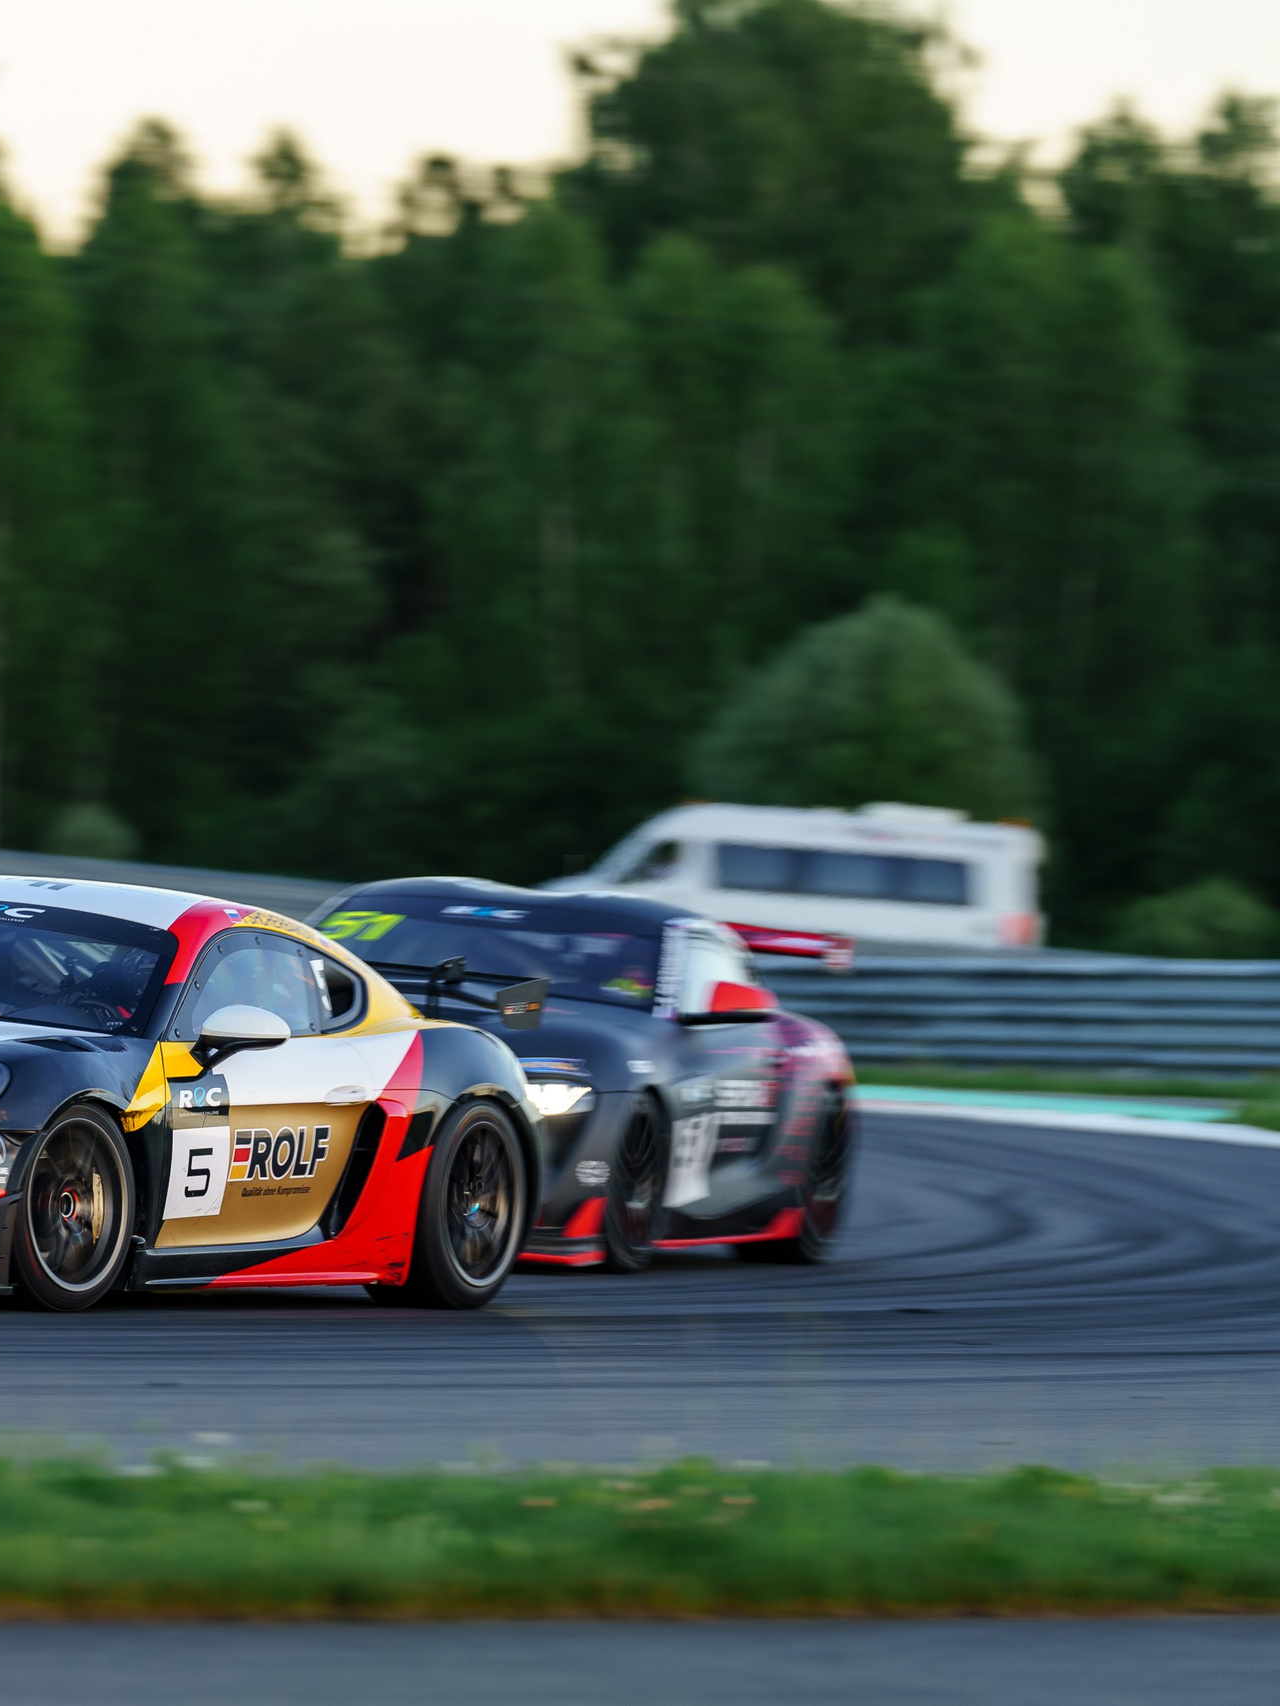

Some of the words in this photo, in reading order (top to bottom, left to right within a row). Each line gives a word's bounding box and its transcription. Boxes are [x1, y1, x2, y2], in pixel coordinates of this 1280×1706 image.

[318, 910, 408, 941] 51
[184, 1147, 214, 1198] 5
[246, 1124, 332, 1181] ROLF
